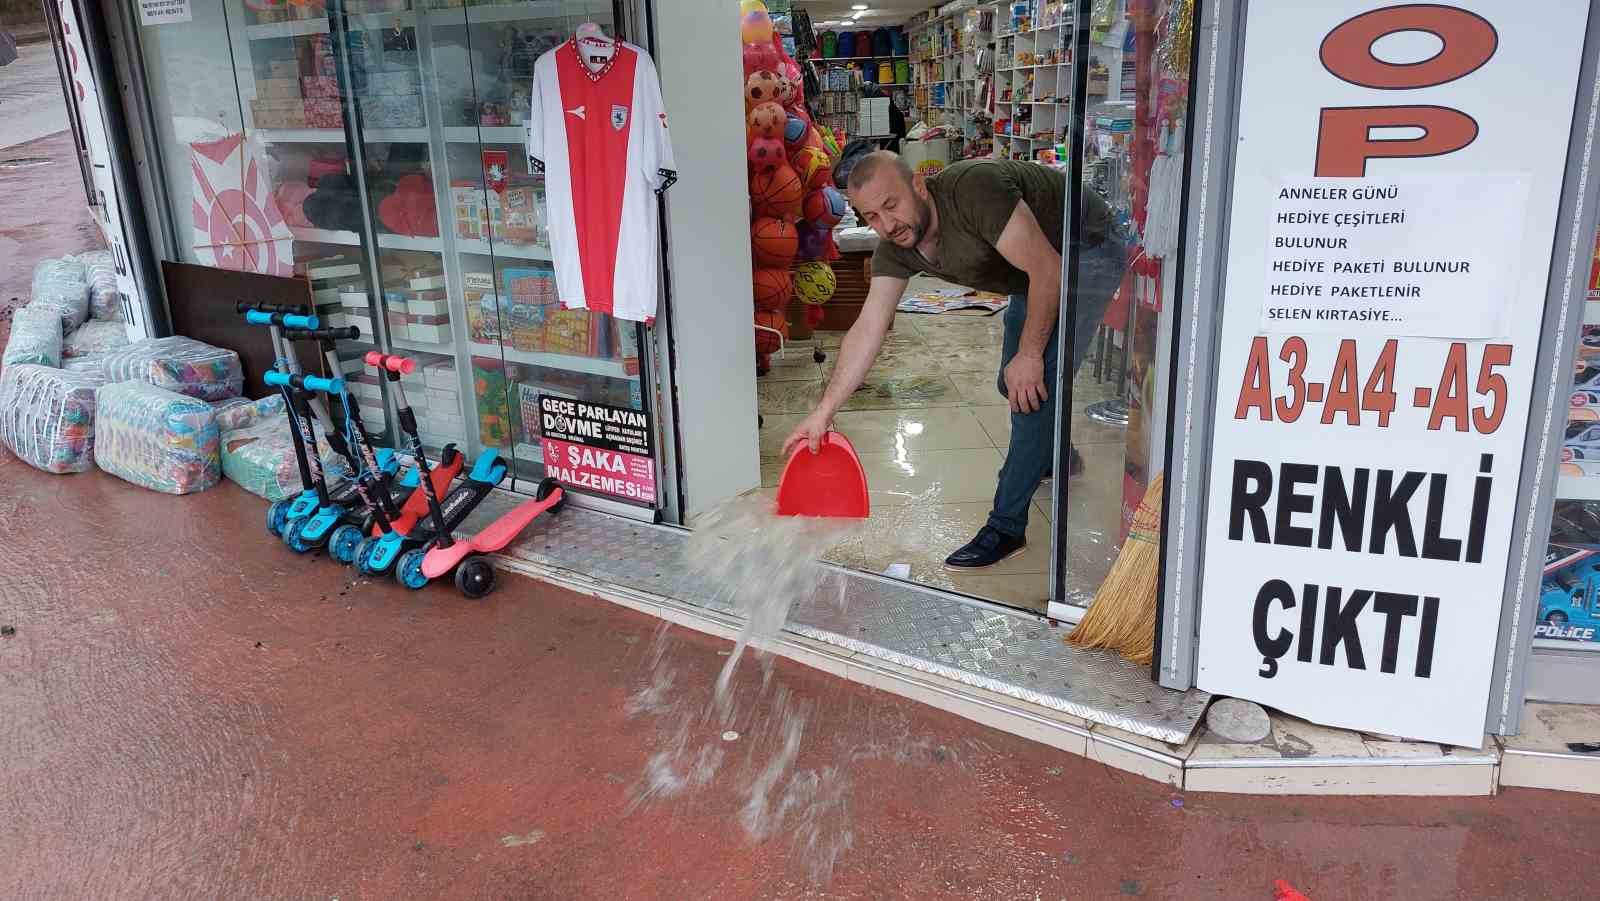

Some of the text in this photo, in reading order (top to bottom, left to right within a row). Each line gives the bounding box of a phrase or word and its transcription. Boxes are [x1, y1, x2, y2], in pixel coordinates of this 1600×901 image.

[1279, 185, 1397, 199] ANNELER GÜNÜ
[1278, 210, 1404, 227] HEDİYE ÇEŞİTLERİ
[1276, 237, 1347, 248] BULUNUR
[1274, 260, 1469, 273] HEDİYE PAKETİ BULUNUR
[1272, 283, 1420, 297] HEDİYE PAKETLENİR
[1269, 308, 1401, 320] SELEN KIRTASİYE...
[543, 399, 646, 427] GECE PARLAYAN
[544, 413, 602, 439] DÖVME
[568, 446, 627, 475] ŞAKA
[1229, 454, 1493, 563] RENKLİ
[1253, 580, 1440, 678] ÇIKTI
